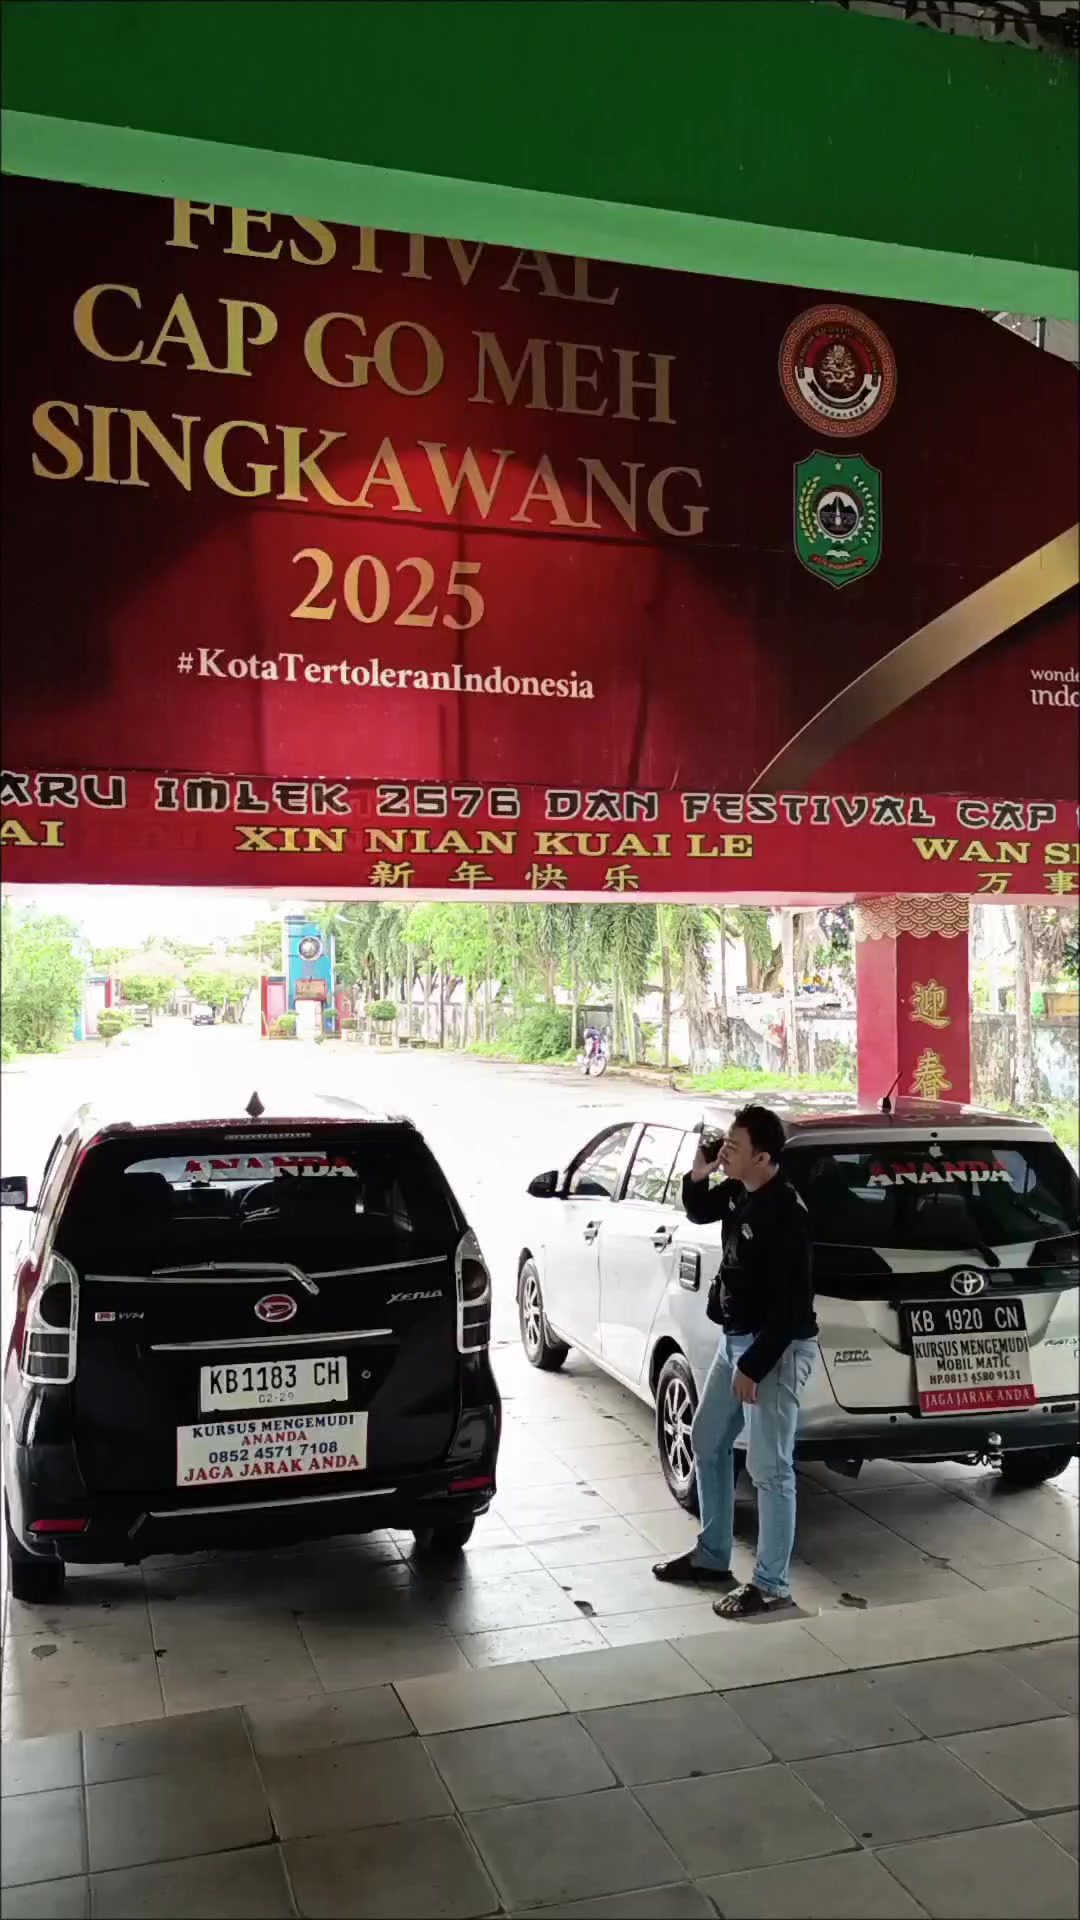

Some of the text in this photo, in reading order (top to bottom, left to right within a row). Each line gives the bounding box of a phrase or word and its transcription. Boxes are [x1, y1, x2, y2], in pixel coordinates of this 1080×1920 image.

[73, 283, 677, 425] CAP GO MEH
[31, 400, 710, 537] SINGKAWANG
[290, 547, 485, 631] 2025
[177, 648, 595, 701] #KotaTertoleranIndonesia
[155, 777, 352, 815] IMLEK
[376, 785, 520, 819] 2576
[545, 789, 659, 822] DAN
[681, 792, 935, 828] FESTIVAL
[956, 800, 1056, 831] CAP
[234, 826, 348, 852] XIN
[364, 829, 518, 855] NIAN
[533, 831, 671, 857] KUAI
[686, 833, 753, 858] LE
[912, 837, 1031, 864] WAN
[368, 861, 640, 893] 新年快乐
[909, 979, 952, 1100] 迎春
[867, 1160, 1014, 1187] ANANDA
[910, 1306, 1019, 1333] KB 1920 CN
[915, 1341, 959, 1359] KURSUS
[961, 1337, 1029, 1356] MENGEMUDI
[314, 1361, 340, 1386] CH
[937, 1355, 1012, 1371] MOBIL MATIC
[925, 1388, 1031, 1408] JAGA JARAK ANDA
[193, 1414, 354, 1438] KURSUS MENGEMUDI
[241, 1430, 308, 1446] ANANDA
[209, 1441, 338, 1464] 0852 4571 7108
[184, 1454, 360, 1482] JAGA JARAK ANDA
